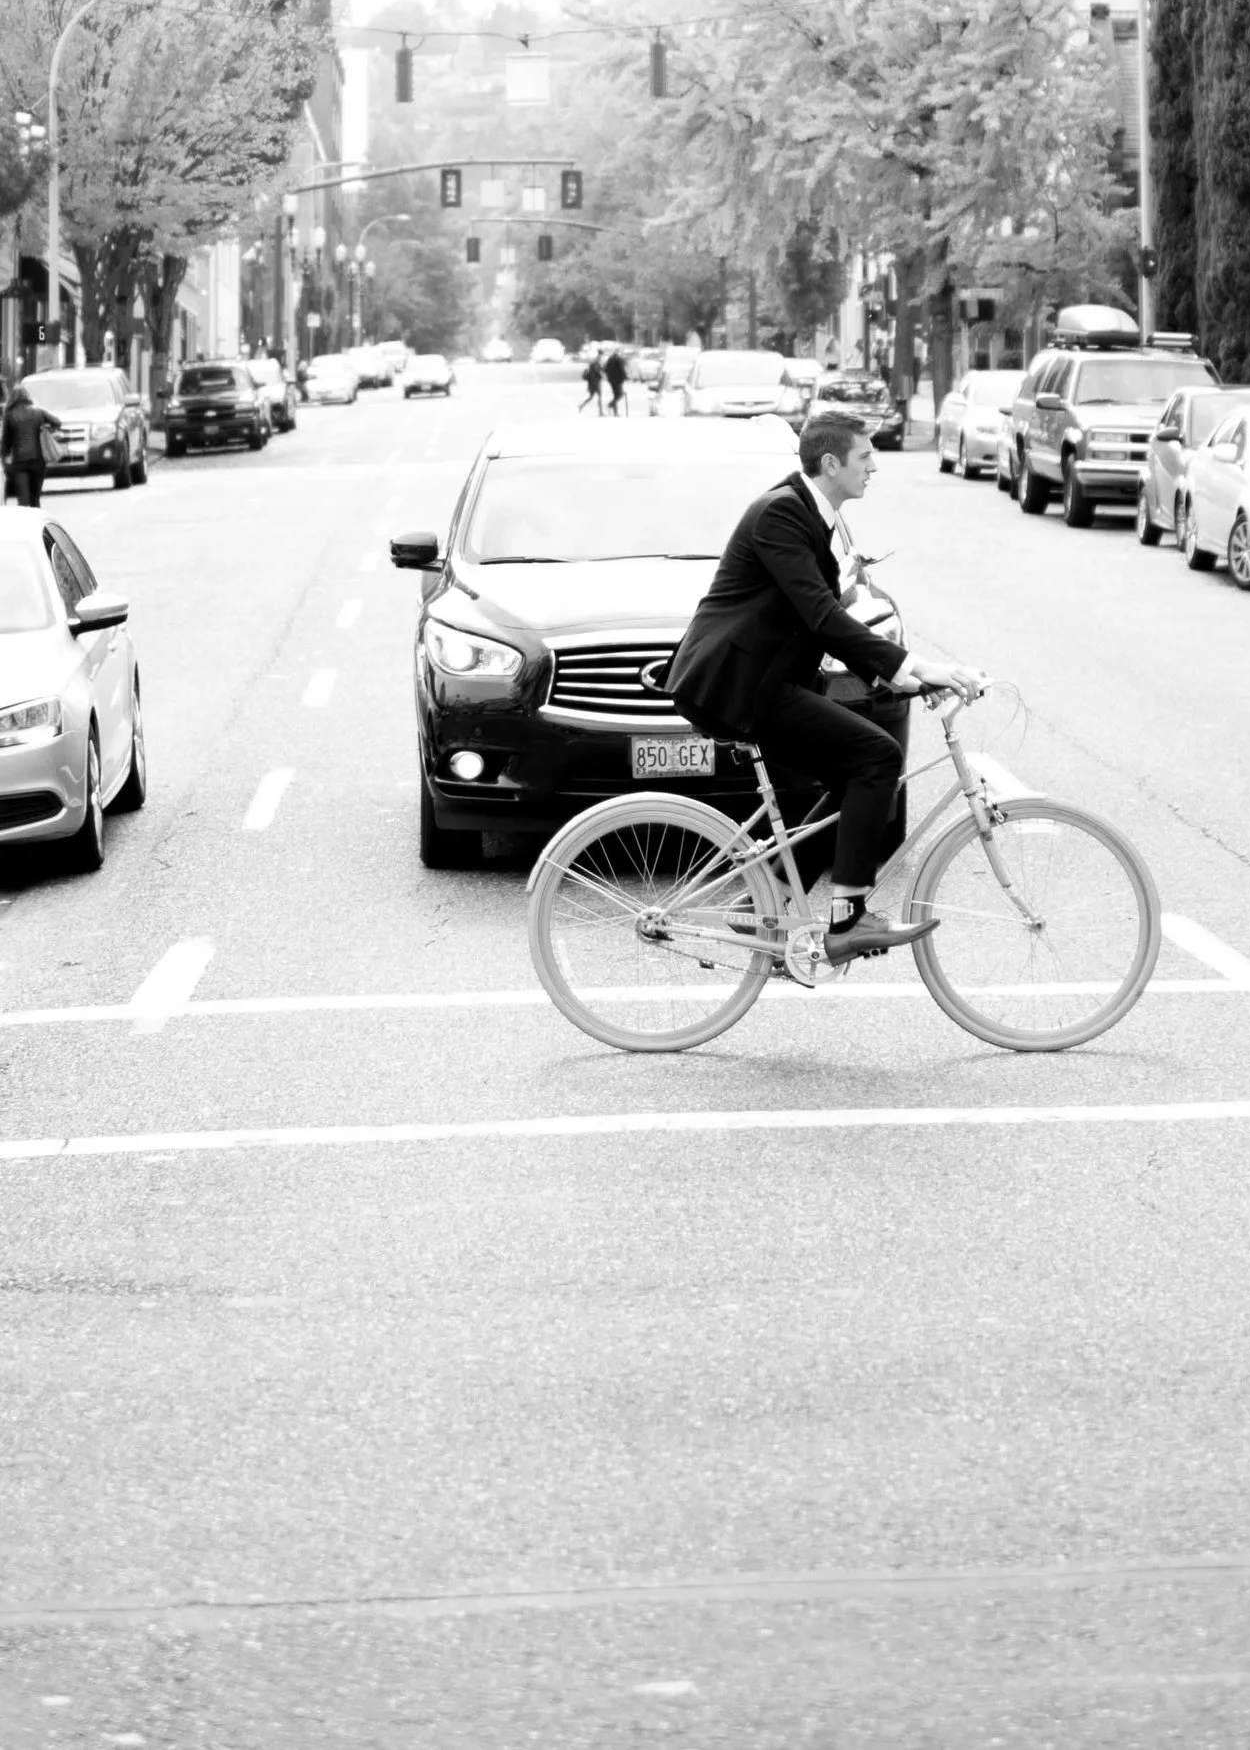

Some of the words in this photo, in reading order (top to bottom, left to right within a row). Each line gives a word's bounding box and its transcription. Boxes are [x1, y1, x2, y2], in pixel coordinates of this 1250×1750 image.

[637, 746, 667, 768] 850
[680, 744, 709, 767] GEX
[722, 913, 761, 925] PUBLIC
